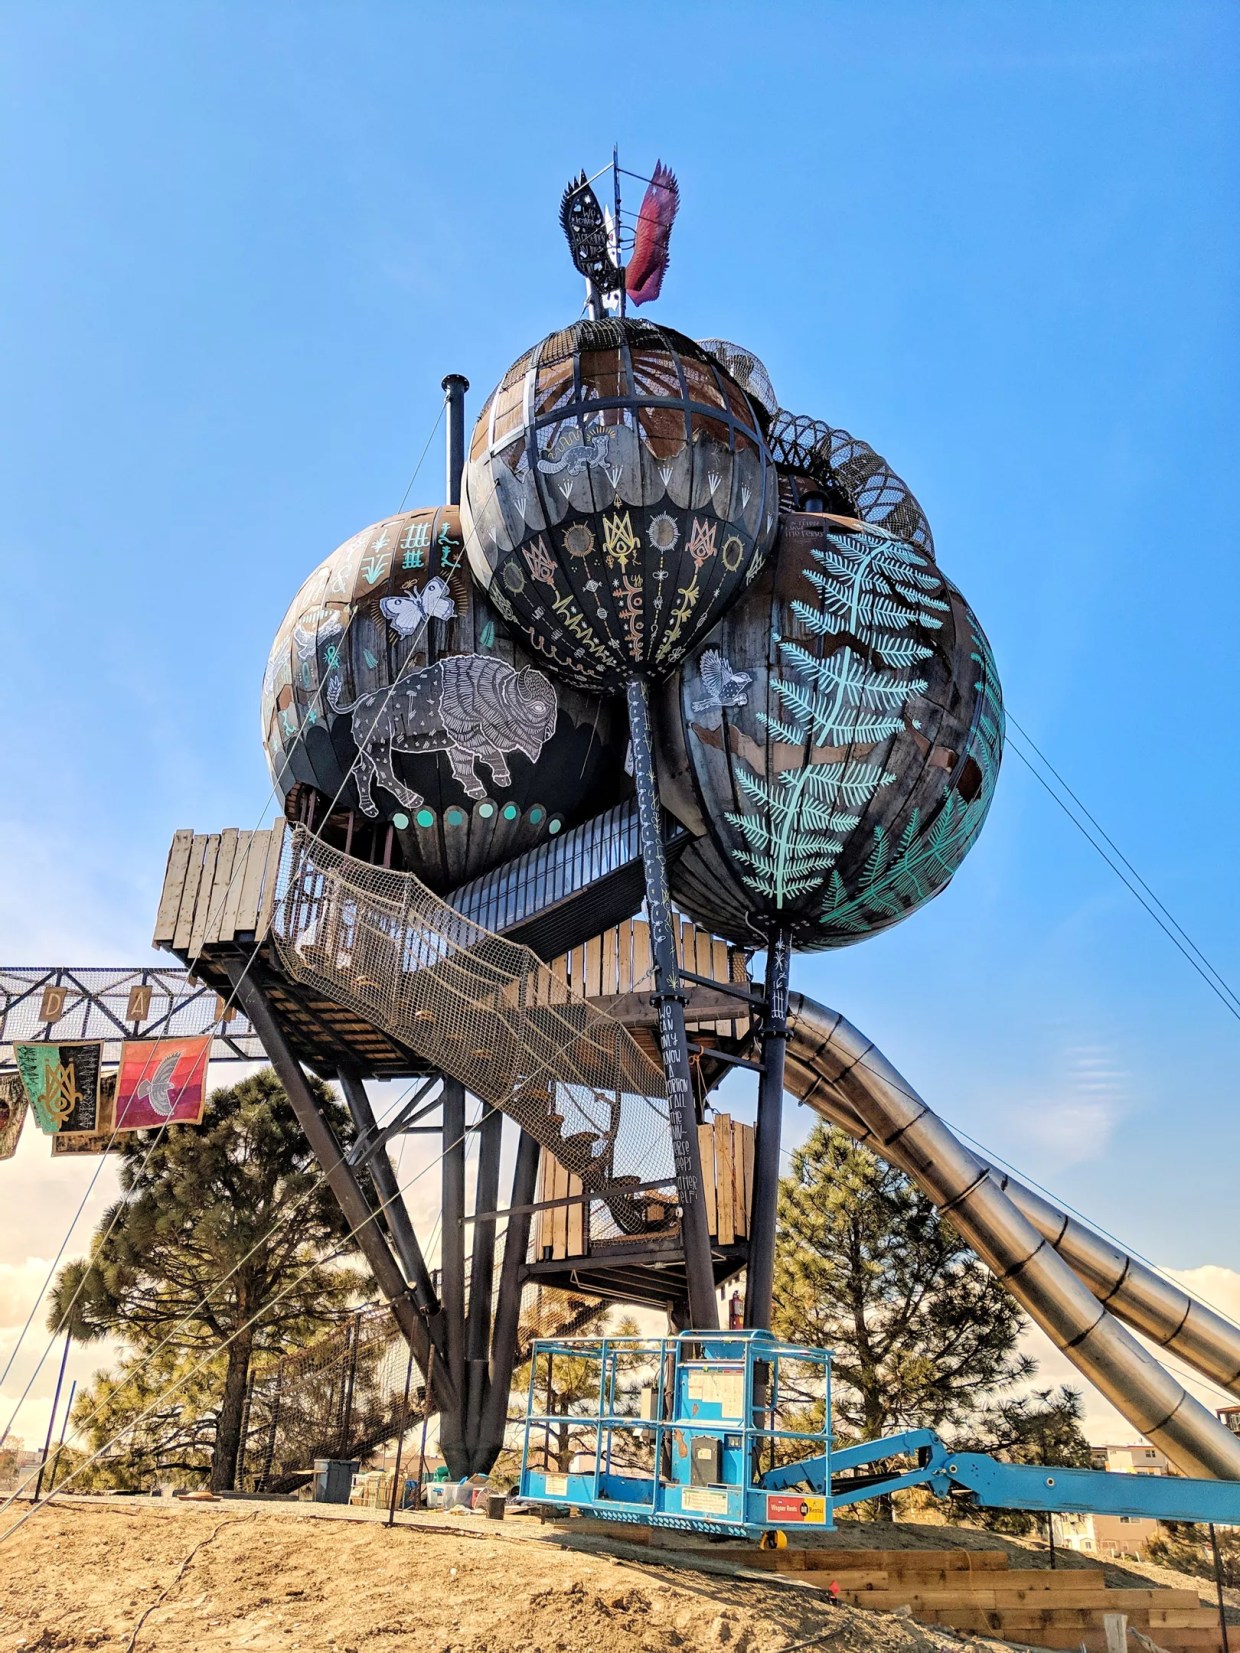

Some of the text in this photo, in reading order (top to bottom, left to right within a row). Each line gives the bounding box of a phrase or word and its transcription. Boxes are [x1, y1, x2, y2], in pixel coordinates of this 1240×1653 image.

[46, 993, 60, 1015] D
[131, 993, 144, 1015] A
[669, 1064, 675, 1078] A
